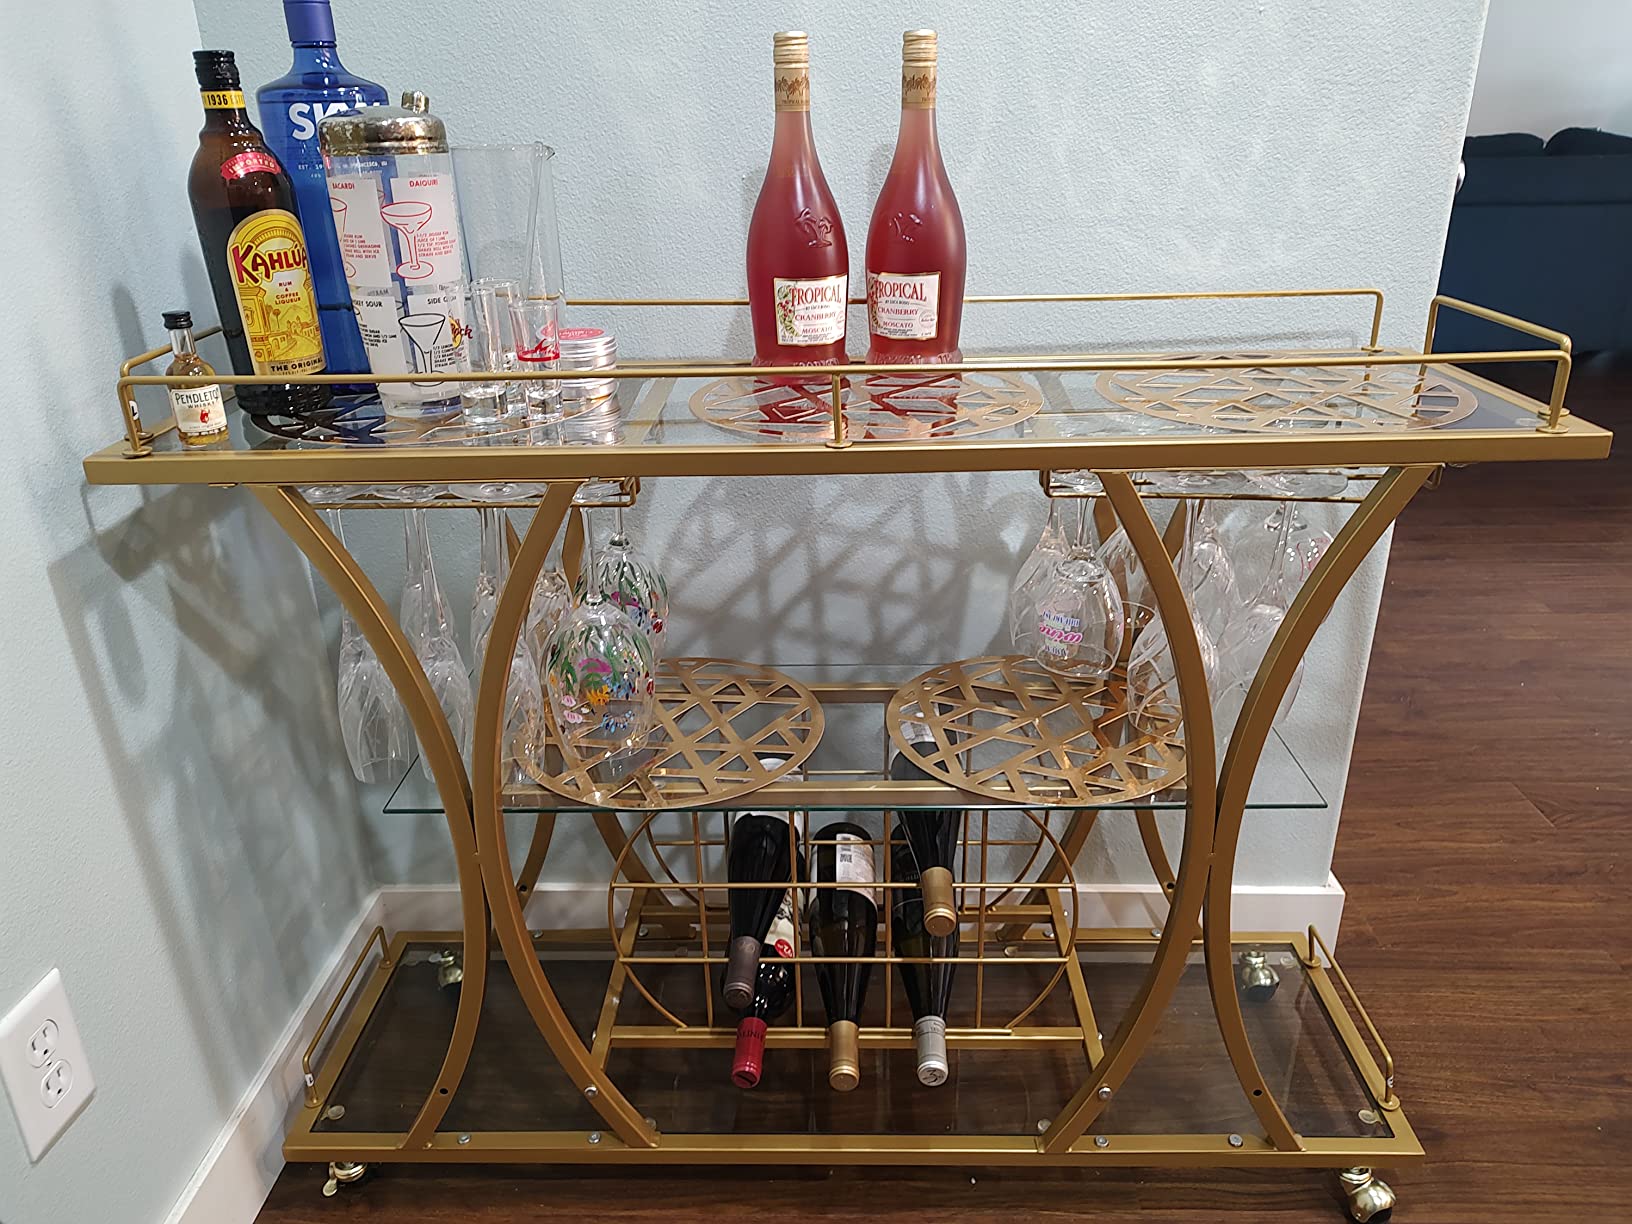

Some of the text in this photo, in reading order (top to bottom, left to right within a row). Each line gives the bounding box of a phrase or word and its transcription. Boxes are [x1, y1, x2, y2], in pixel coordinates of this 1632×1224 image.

[207, 94, 228, 106] 1936
[275, 291, 299, 300] COFFEE
[789, 284, 842, 307] TROPICAL
[873, 280, 927, 302] TROPICAL
[274, 297, 301, 305] LIQUEUR
[365, 300, 383, 308] SOUR
[878, 306, 919, 316] CRANBERRY
[795, 311, 836, 321] CRANBERRY
[882, 320, 914, 329] MOSCATO
[802, 326, 833, 335] MOSCATO
[271, 364, 289, 372] THE
